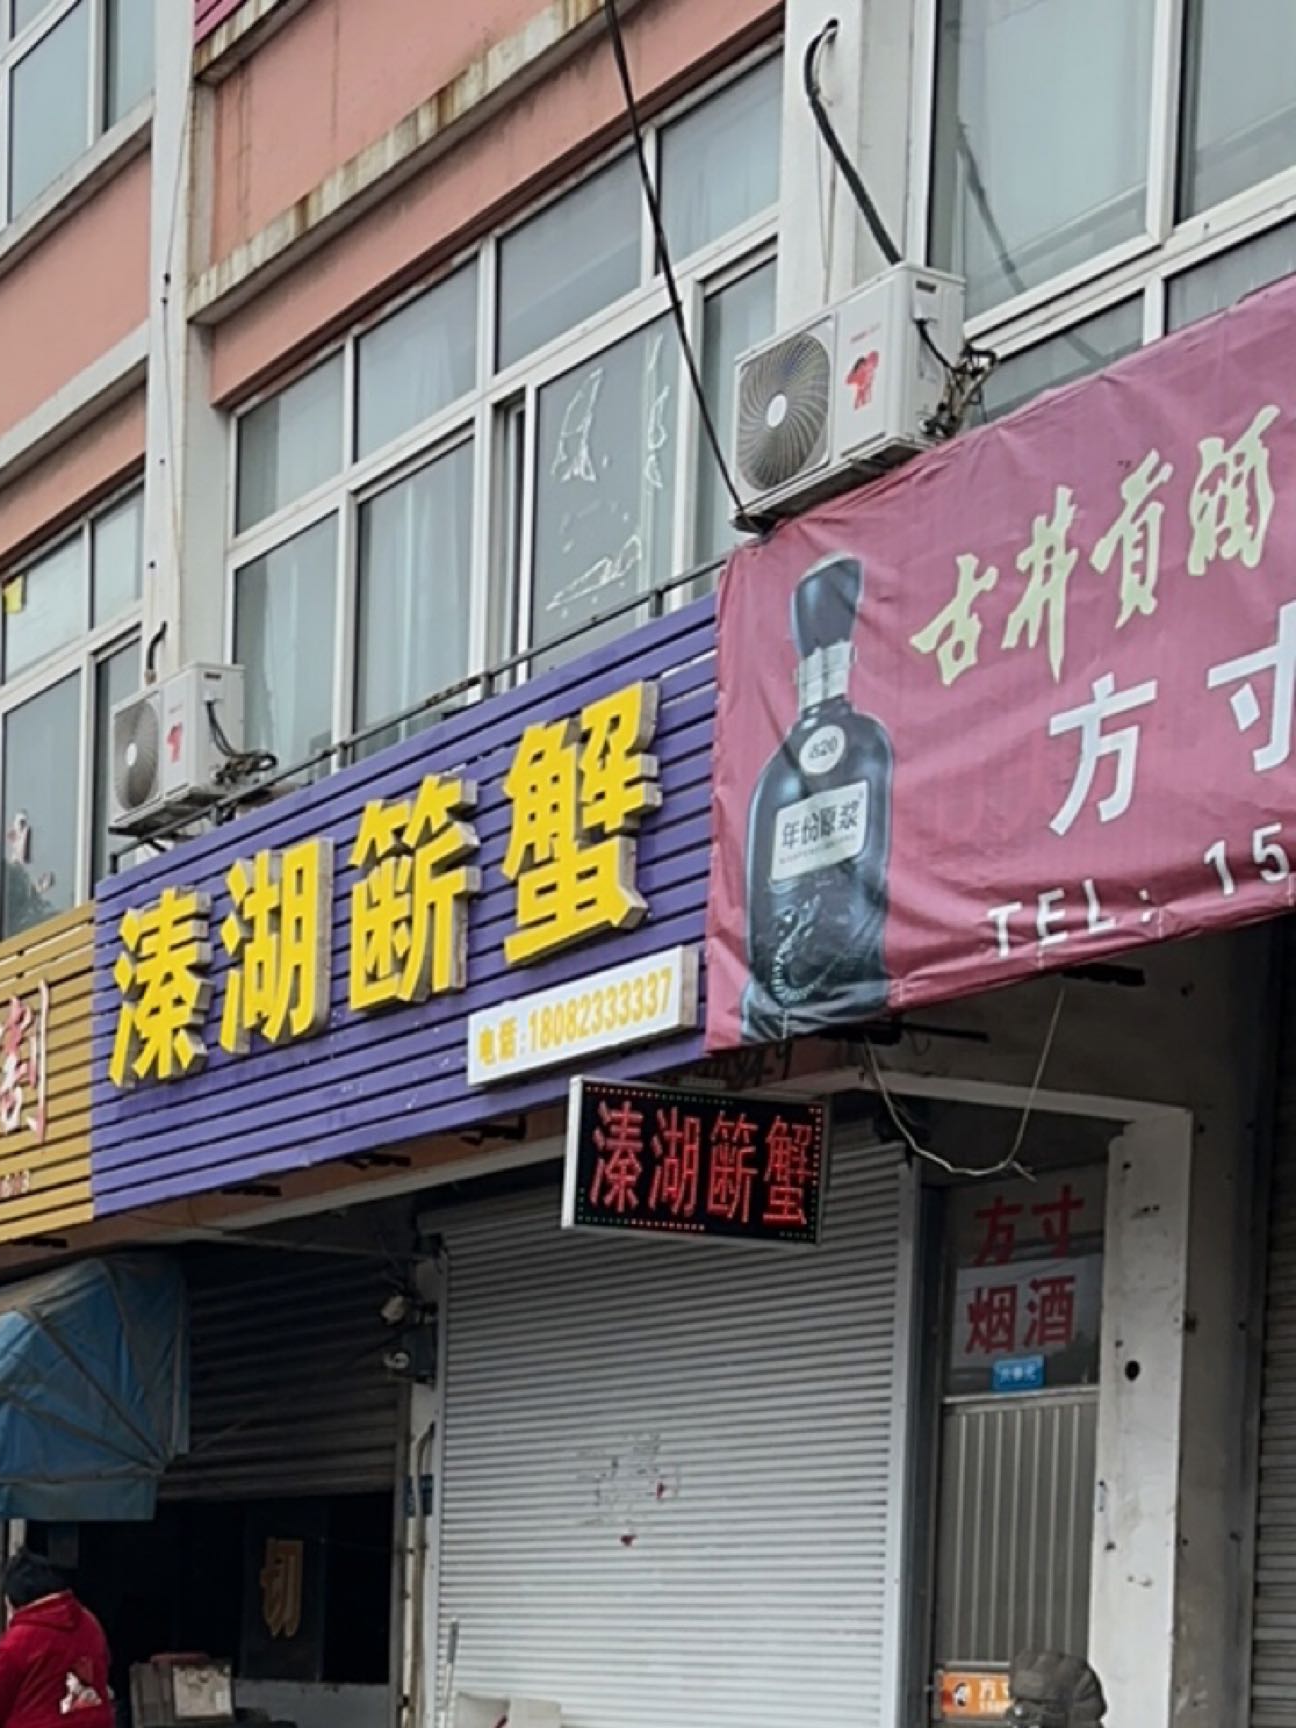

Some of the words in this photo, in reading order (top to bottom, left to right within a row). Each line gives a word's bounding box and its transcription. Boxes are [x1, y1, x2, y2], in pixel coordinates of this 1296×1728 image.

[1048, 600, 1296, 835] 方寸
[972, 1184, 1086, 1268] 方寸
[963, 1274, 1077, 1355] 烟酒
